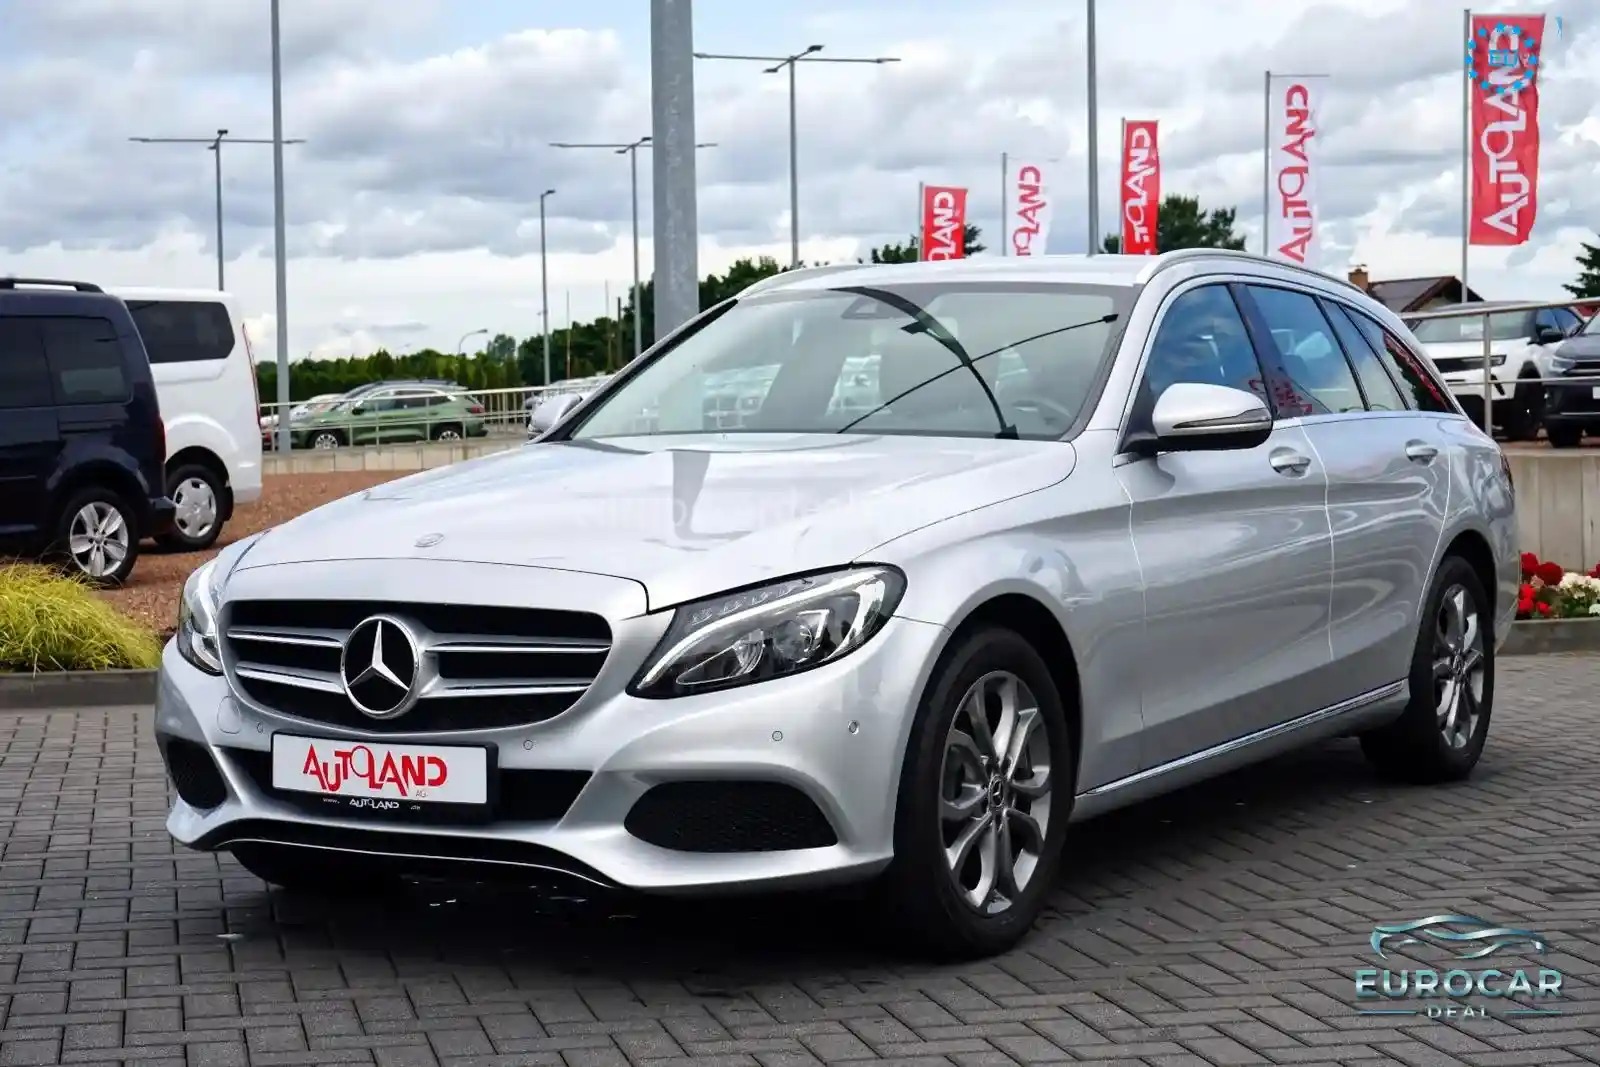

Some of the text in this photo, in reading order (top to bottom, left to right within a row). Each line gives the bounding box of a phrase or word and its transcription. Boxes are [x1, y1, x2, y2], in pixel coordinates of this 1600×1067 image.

[1278, 84, 1315, 263] AUTOLAND
[303, 743, 447, 796] AUTOLAND
[349, 798, 400, 810] AUTOLAND
